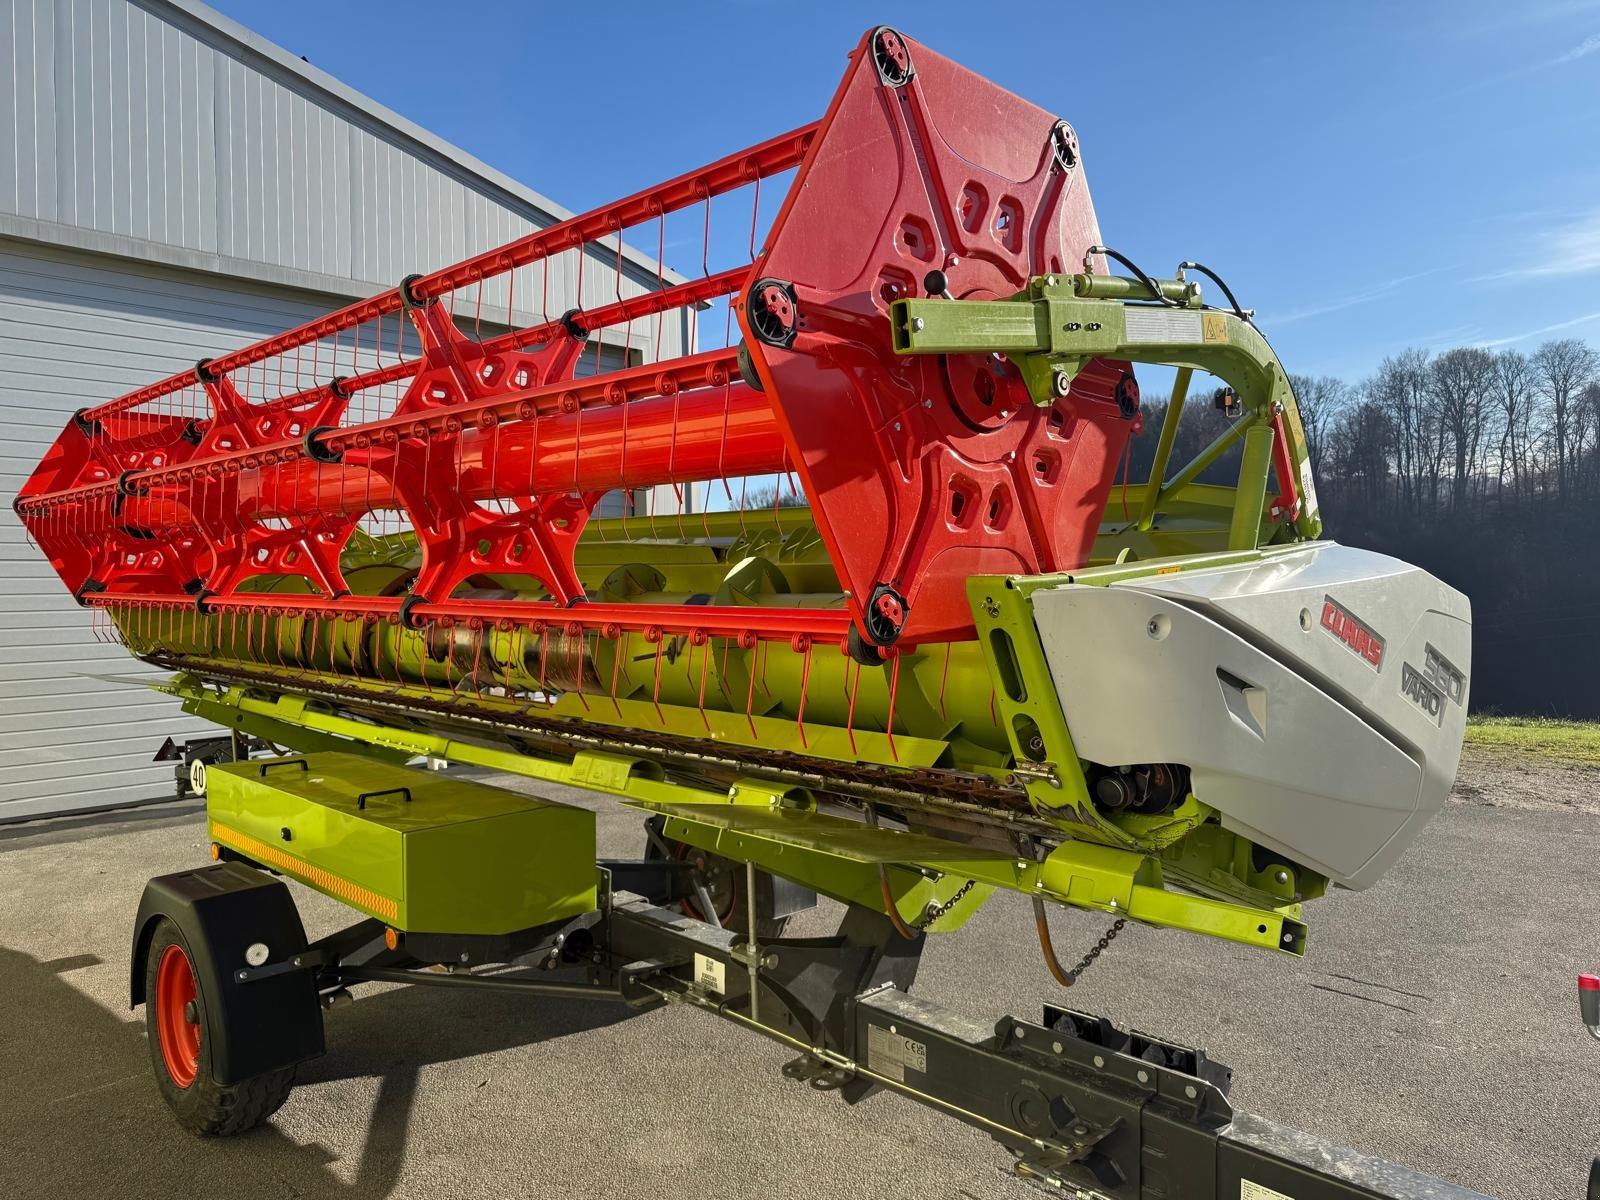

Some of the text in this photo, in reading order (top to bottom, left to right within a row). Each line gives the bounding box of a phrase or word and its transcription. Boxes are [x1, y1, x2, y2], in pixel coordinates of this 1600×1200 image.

[1321, 601, 1383, 666] CLAAS
[1402, 664, 1440, 716] VARIO
[193, 765, 204, 788] 40
